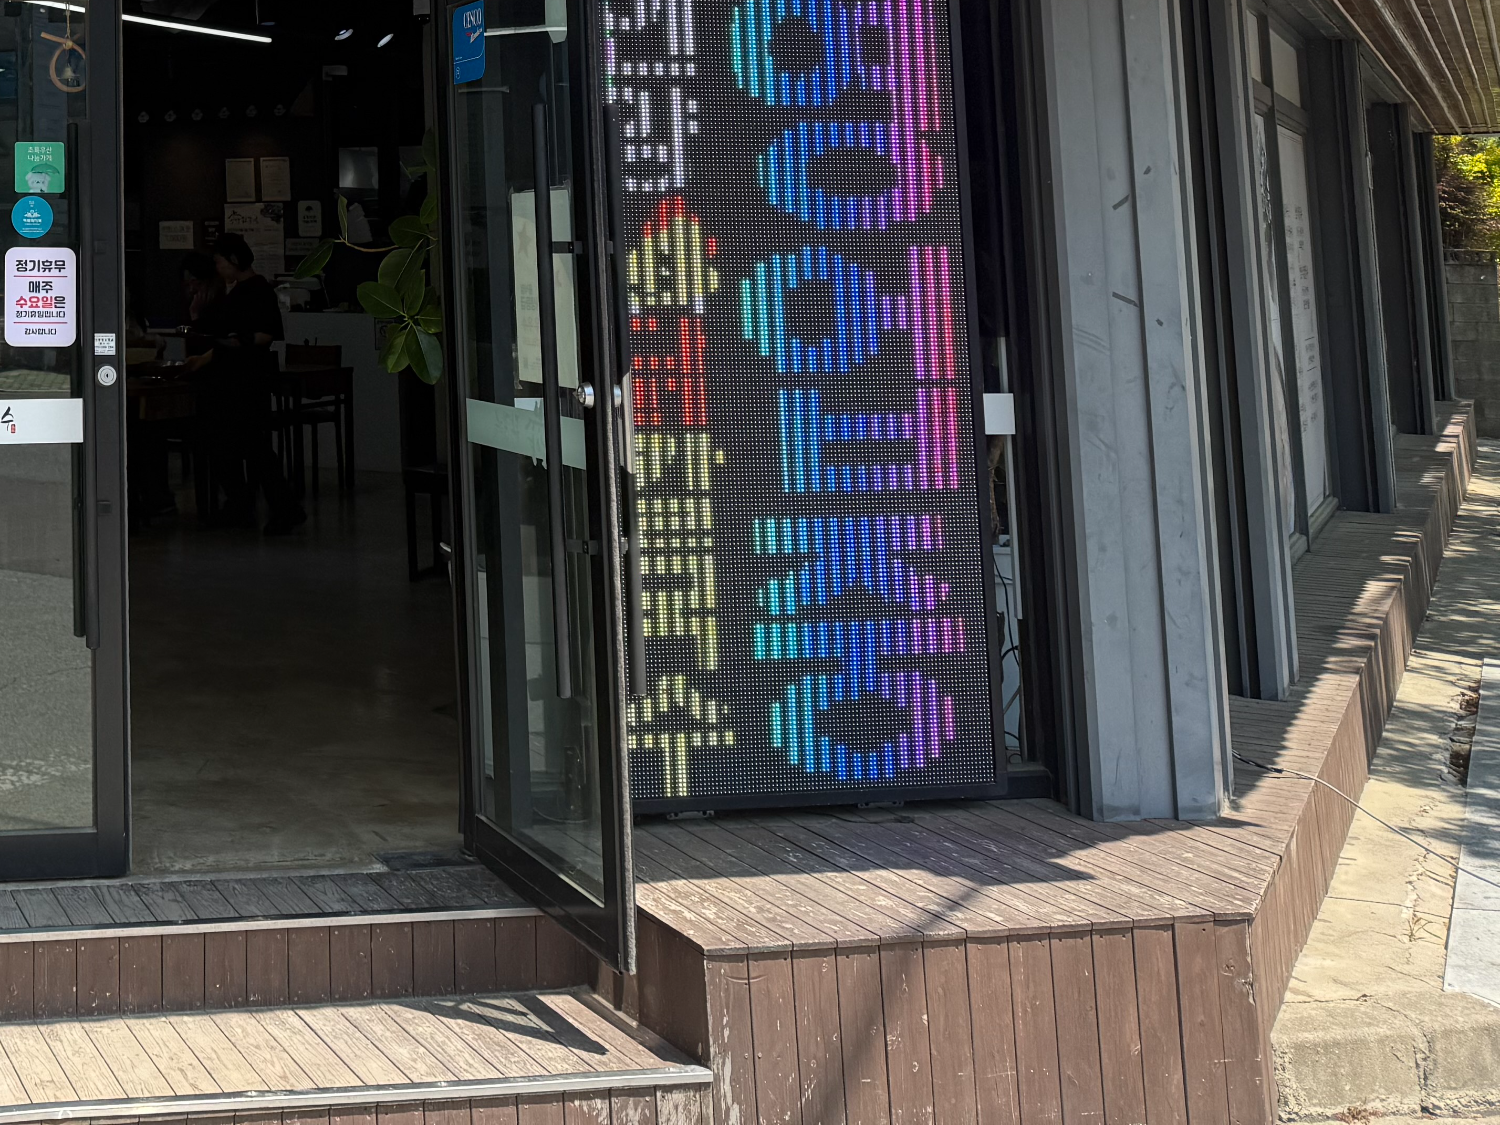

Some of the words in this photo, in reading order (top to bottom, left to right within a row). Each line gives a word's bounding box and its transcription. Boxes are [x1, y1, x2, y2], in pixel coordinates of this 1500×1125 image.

[15, 259, 67, 273] 정기휴무
[28, 280, 53, 295] 매주
[15, 295, 66, 309] 수요일은
[15, 310, 66, 319] 정기휴일입니다
[24, 328, 57, 336] 감사합니다
